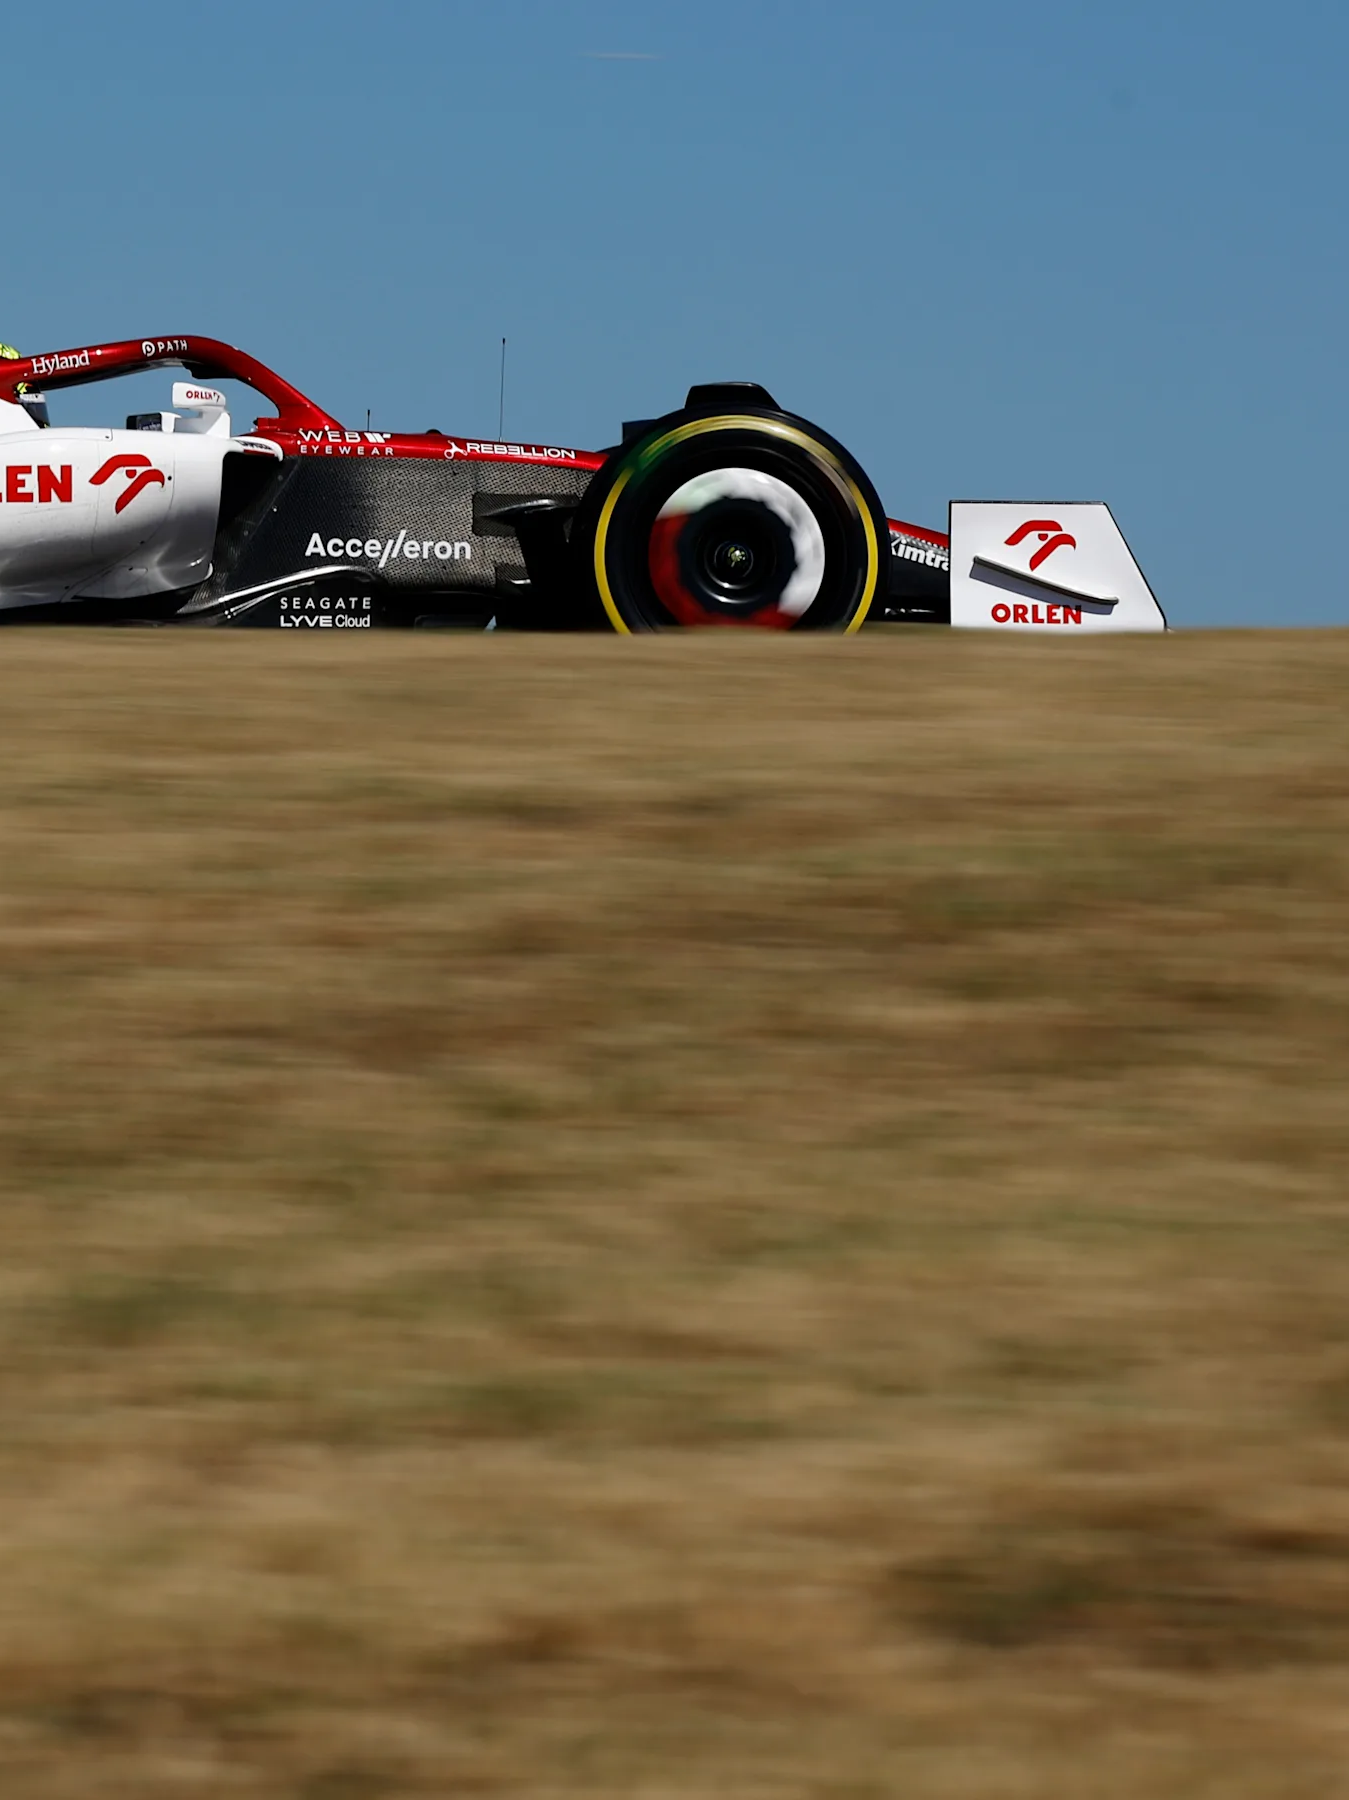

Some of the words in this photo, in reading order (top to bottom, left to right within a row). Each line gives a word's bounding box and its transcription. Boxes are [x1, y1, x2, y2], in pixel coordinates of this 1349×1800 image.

[157, 340, 188, 354] PATH
[31, 350, 90, 375] Hyland
[298, 430, 361, 443] WEB
[300, 445, 394, 456] EYEWEAR
[280, 597, 371, 610] SEAGATE
[280, 615, 333, 628] LYVE
[335, 614, 371, 628] Cloud
[991, 603, 1082, 625] ORLEN
